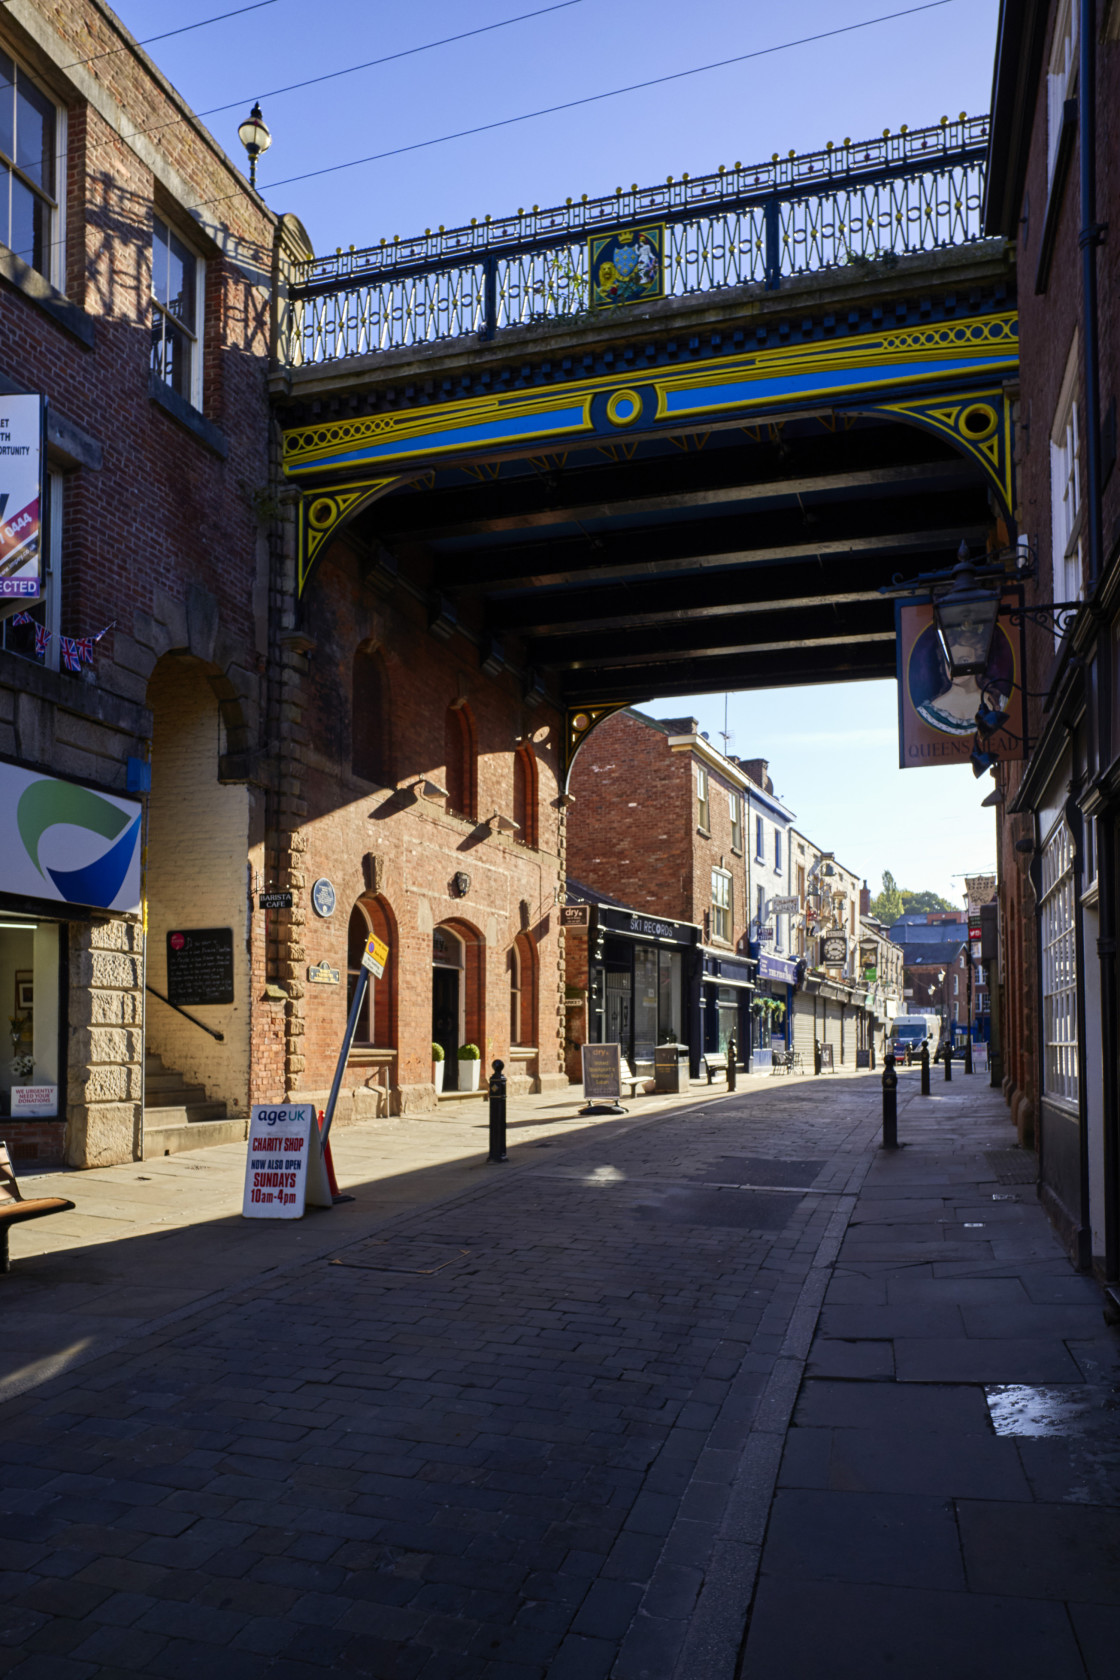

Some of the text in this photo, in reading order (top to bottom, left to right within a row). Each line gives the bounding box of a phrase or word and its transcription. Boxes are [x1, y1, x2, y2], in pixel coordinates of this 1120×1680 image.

[4, 512, 33, 537] 0444
[908, 740, 970, 758] QUEENS
[260, 893, 292, 902] BARISTA
[630, 919, 673, 937] SK1 RECORDS
[288, 1110, 305, 1122] UK
[252, 1137, 304, 1152] CHARITY SHOP
[251, 1159, 302, 1170] NOW ALSO OPEN
[253, 1172, 297, 1188] SUNDAYS
[251, 1188, 297, 1206] 10am-4pm
